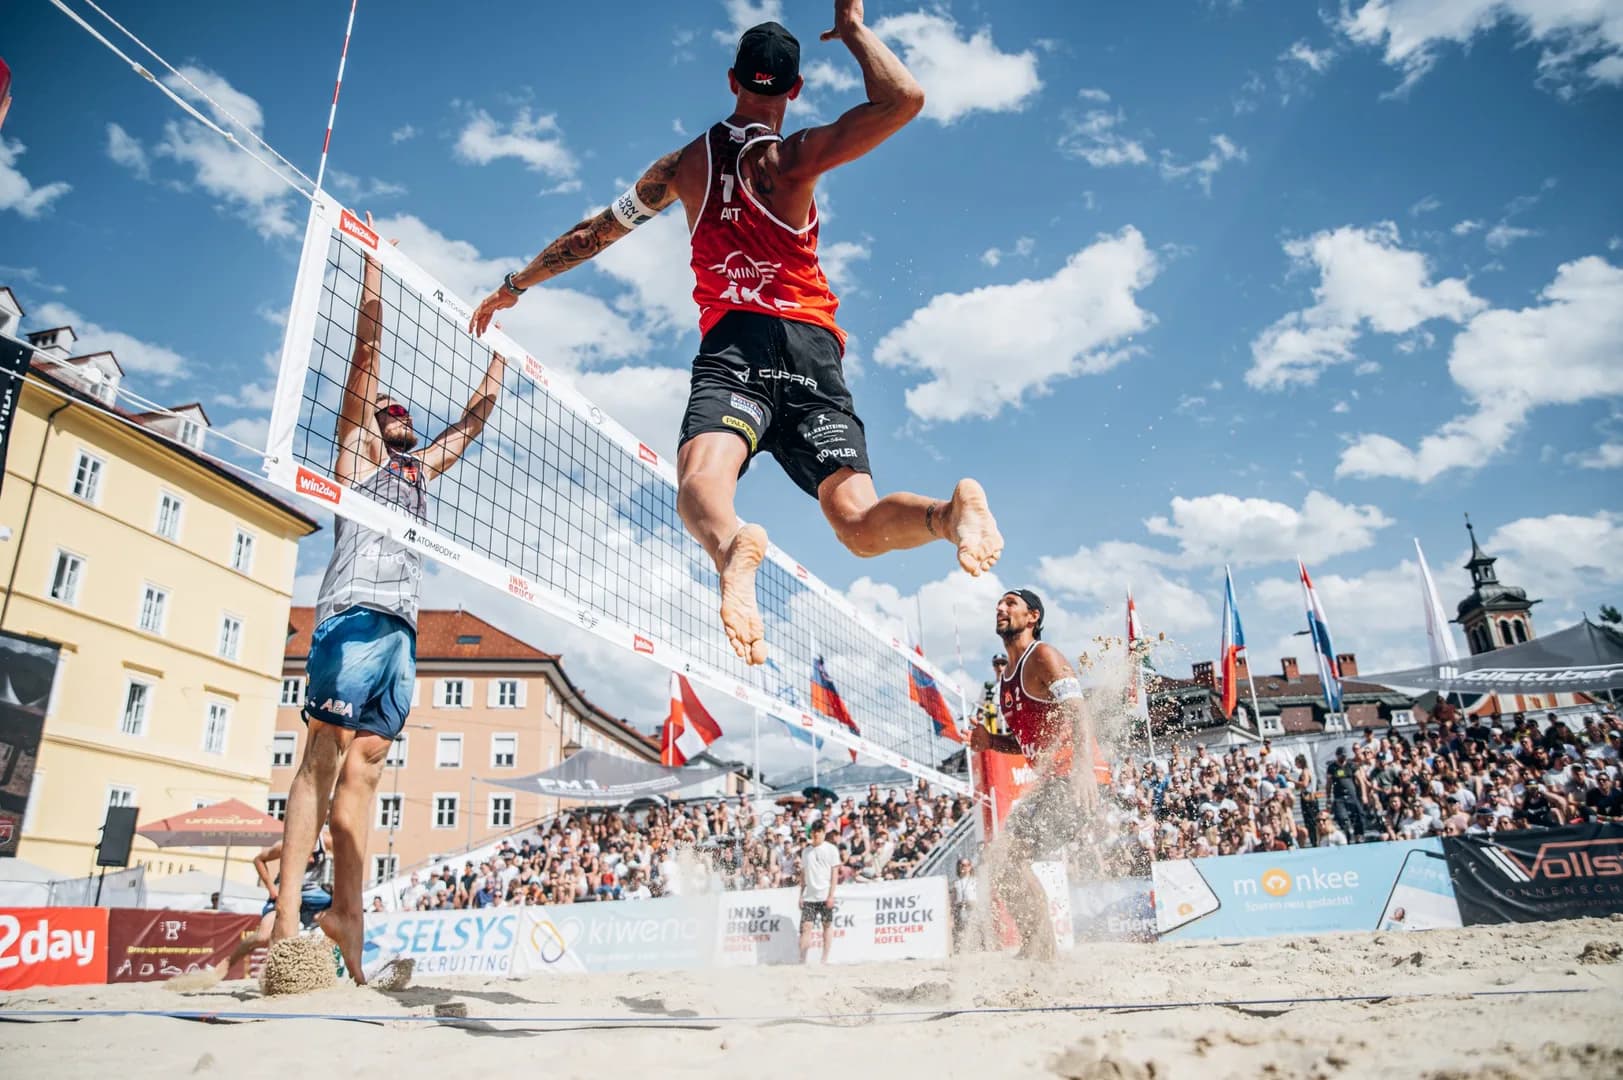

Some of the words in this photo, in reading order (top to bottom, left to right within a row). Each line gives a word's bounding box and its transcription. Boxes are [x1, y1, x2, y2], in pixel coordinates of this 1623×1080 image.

[720, 173, 734, 203] 7
[727, 266, 760, 280] MINI
[758, 368, 818, 391] CUPRA
[300, 475, 337, 500] win2day
[725, 919, 781, 935] BRUCK
[875, 909, 934, 926] BRUCK
[389, 914, 517, 953] SELSYS
[410, 954, 510, 973] ECRUITING
